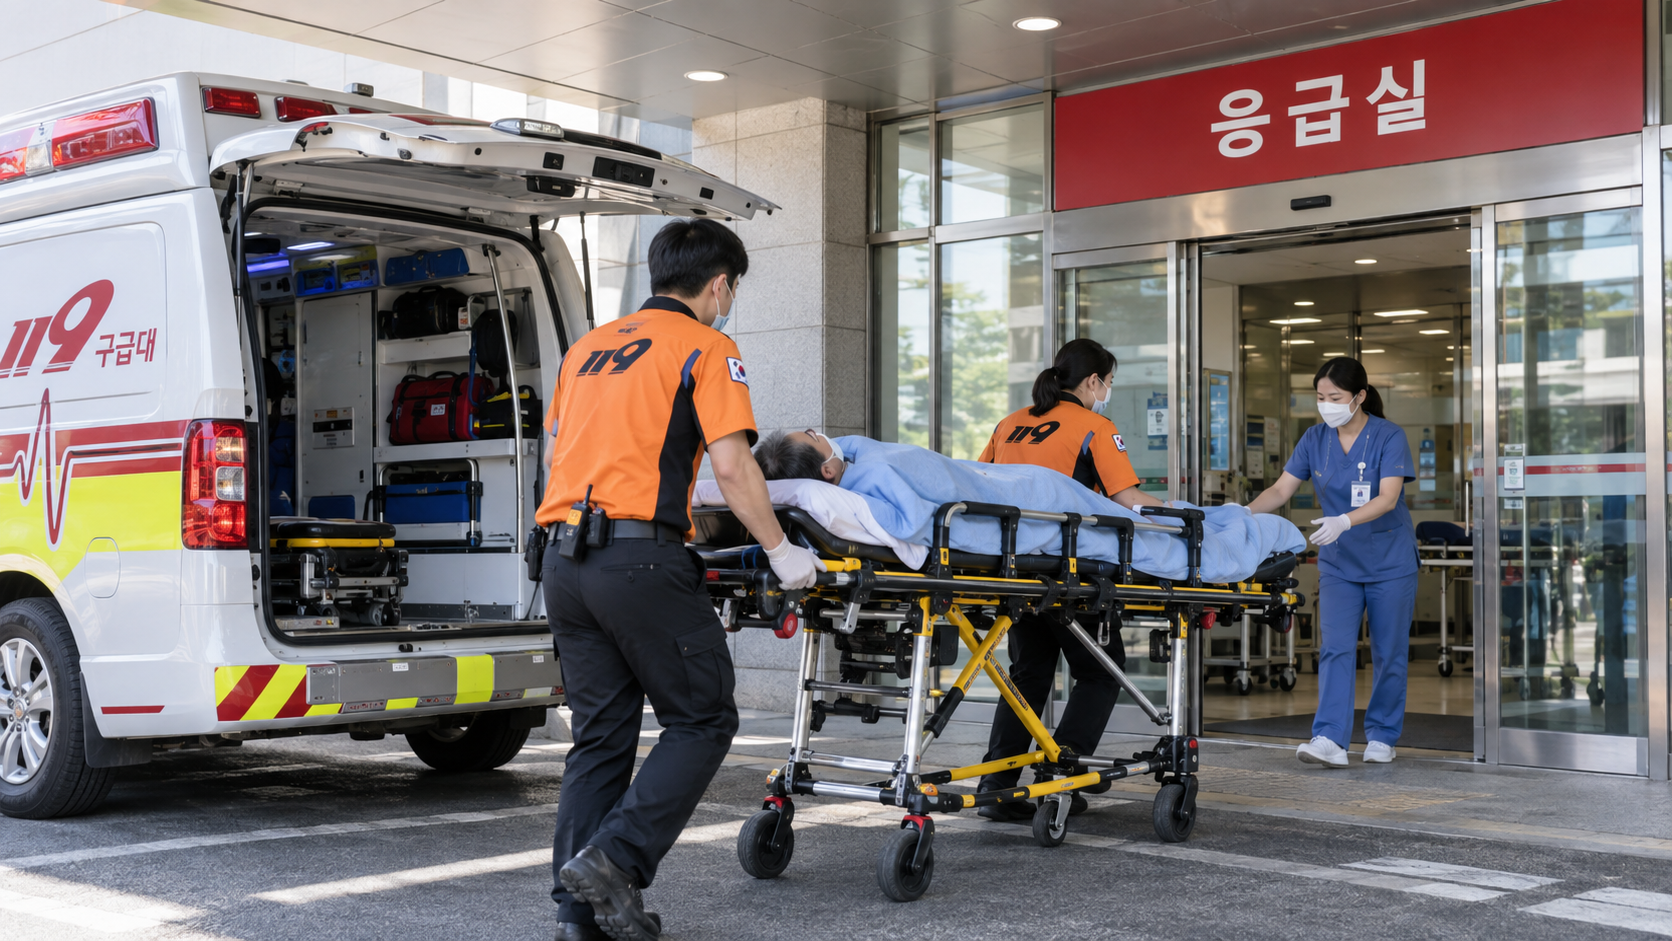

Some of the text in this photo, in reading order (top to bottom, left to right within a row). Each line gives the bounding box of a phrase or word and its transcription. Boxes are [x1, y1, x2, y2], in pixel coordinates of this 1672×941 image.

[1210, 58, 1427, 158] 응급실
[0, 279, 157, 379] 119 구급대
[576, 338, 653, 377] 119
[1005, 420, 1061, 445] 119
